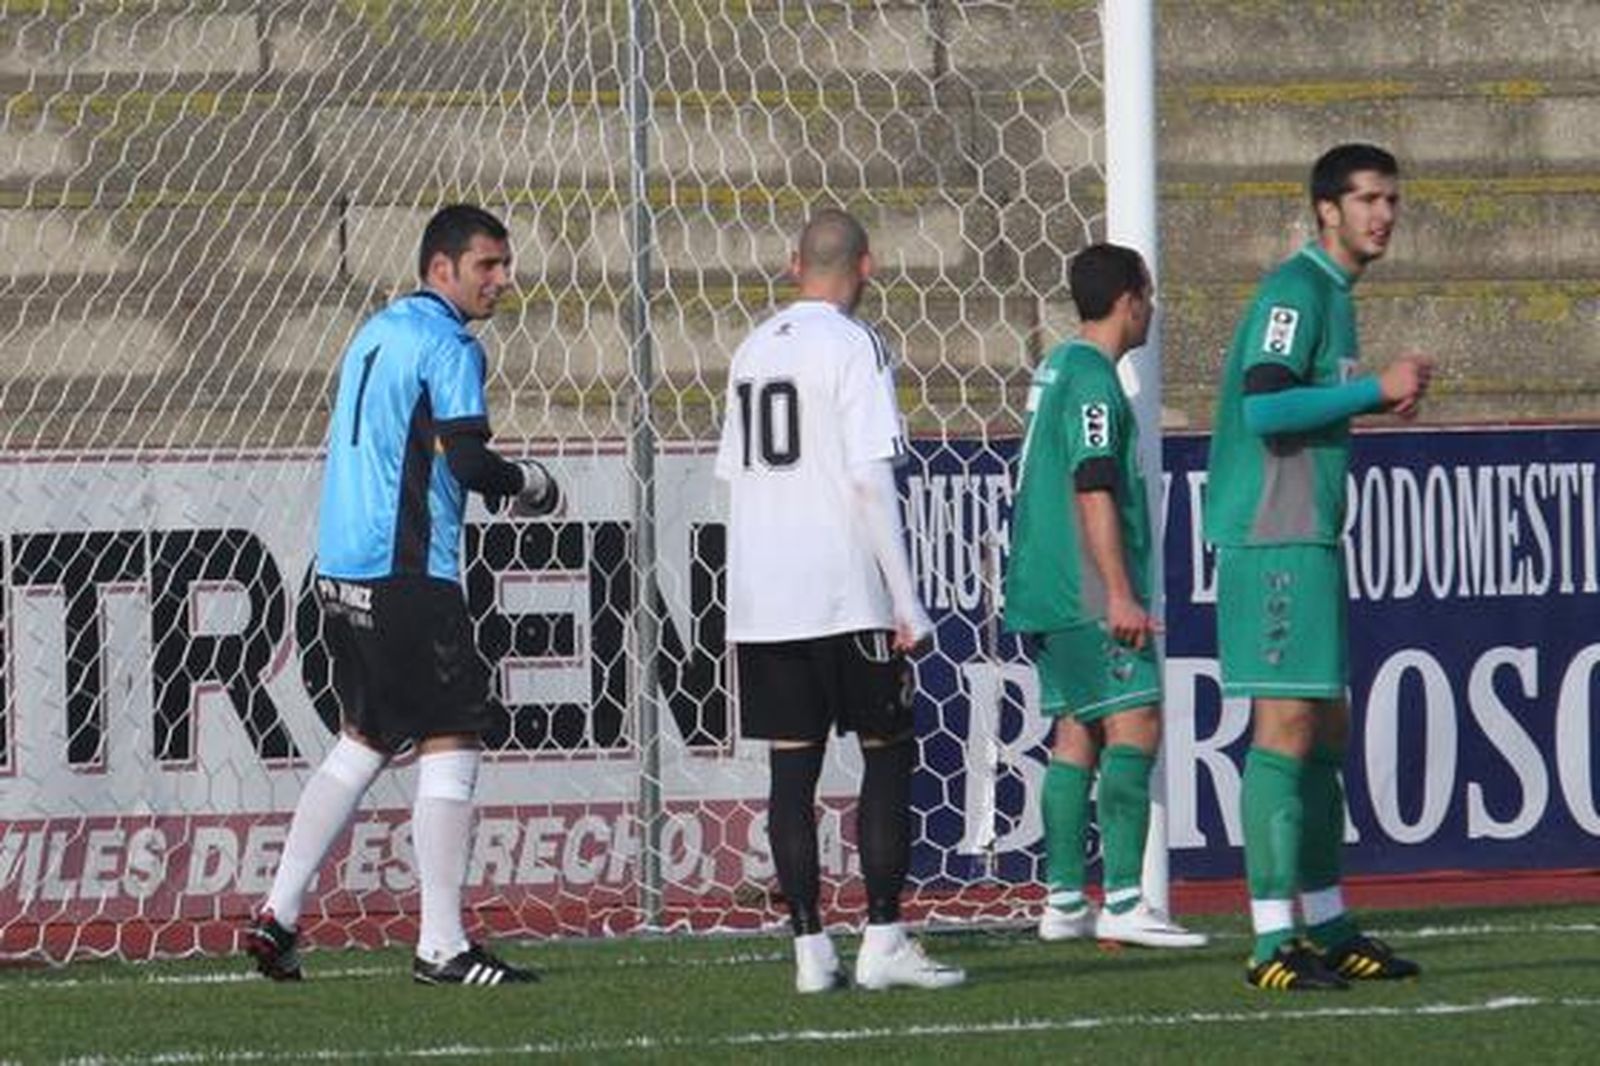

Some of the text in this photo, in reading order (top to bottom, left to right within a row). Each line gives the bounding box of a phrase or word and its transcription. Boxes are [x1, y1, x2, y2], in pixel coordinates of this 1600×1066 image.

[352, 344, 381, 447] 1
[736, 375, 801, 468] 10
[907, 474, 1016, 609] MUE
[1187, 464, 1598, 602] ERODOMESTI
[0, 521, 728, 765] TREN
[957, 643, 1600, 855] BROS
[186, 824, 319, 896] DE
[345, 811, 715, 892] ESRECHO,
